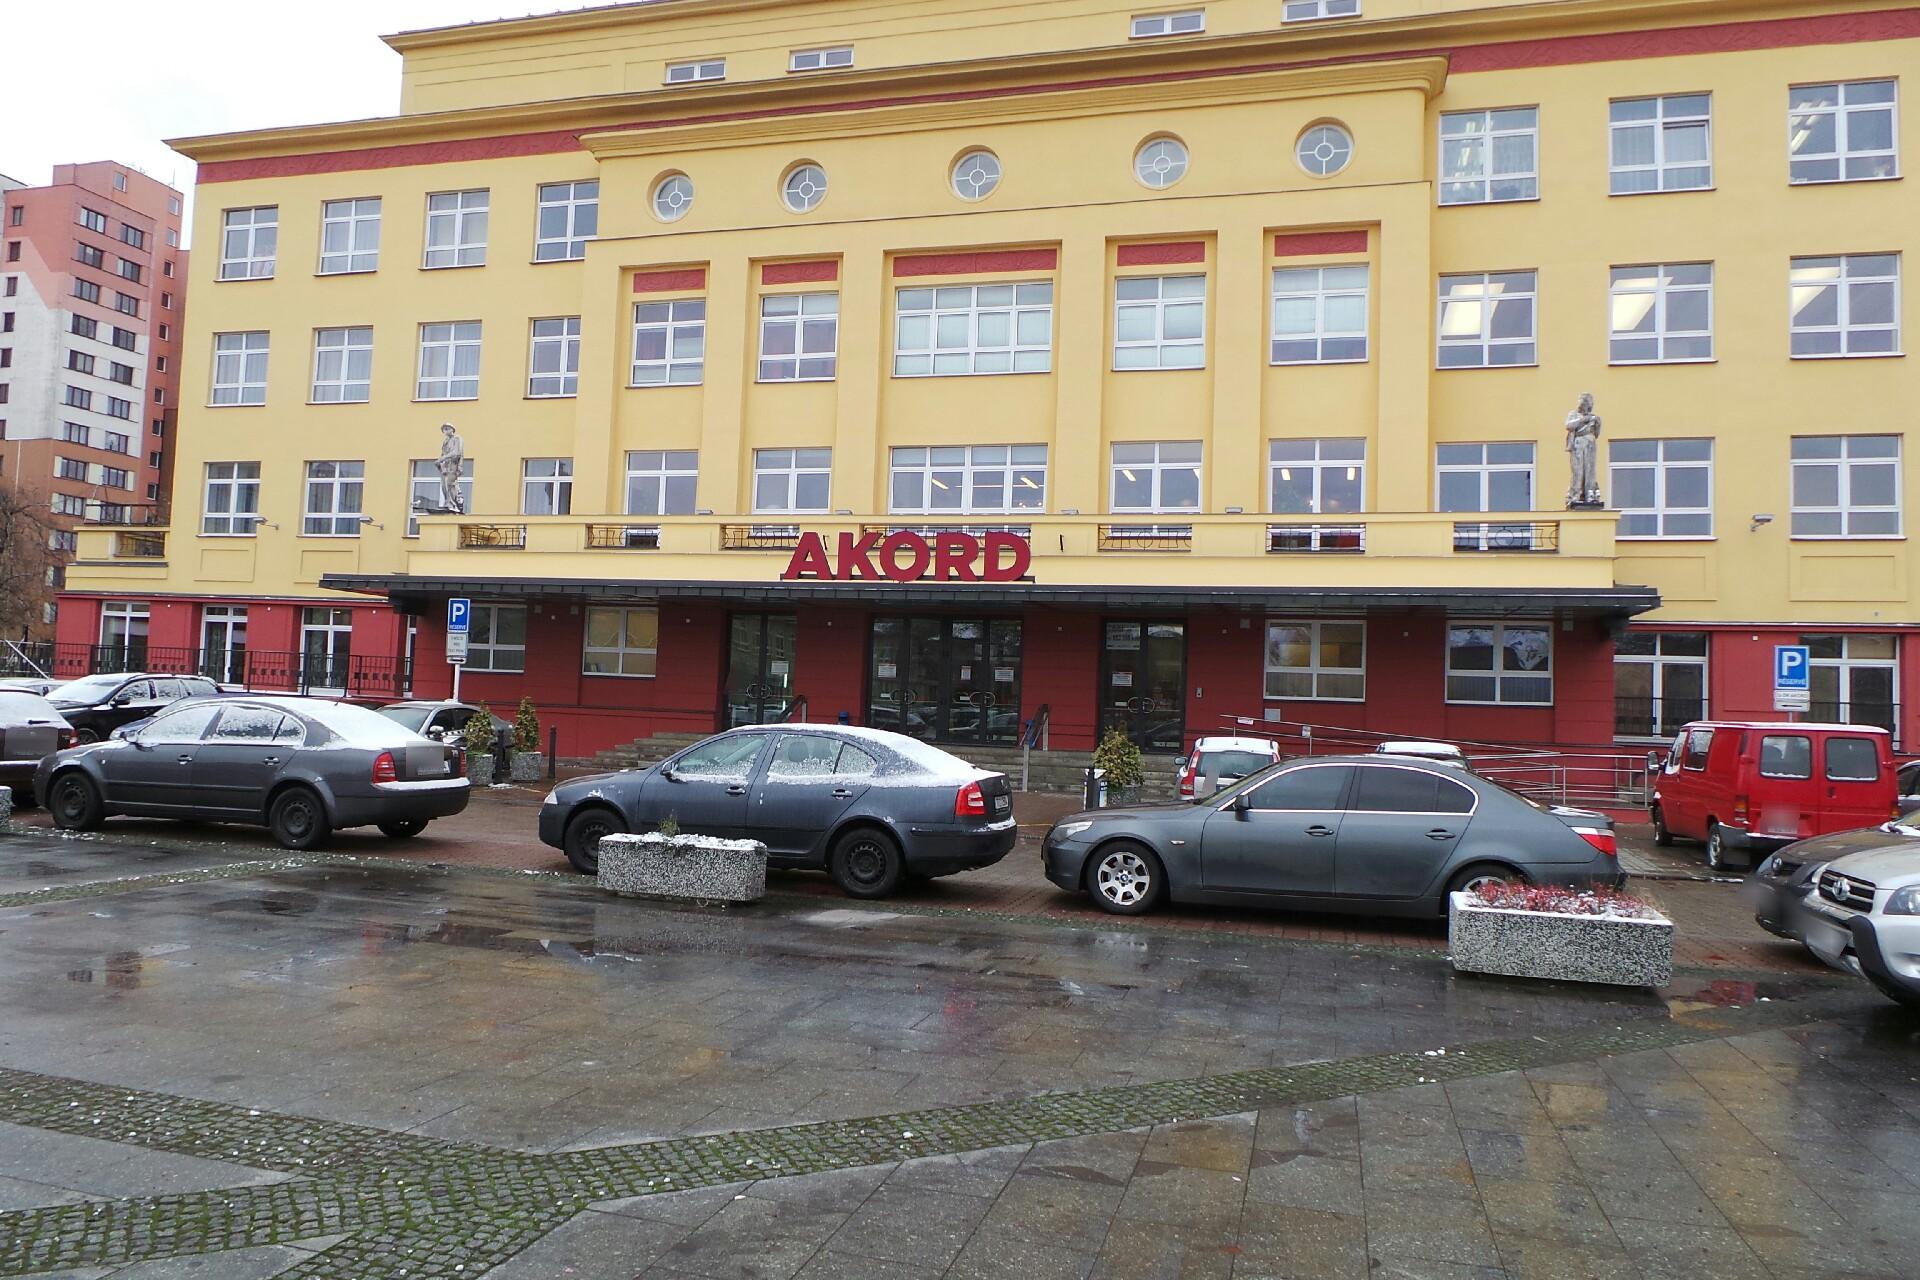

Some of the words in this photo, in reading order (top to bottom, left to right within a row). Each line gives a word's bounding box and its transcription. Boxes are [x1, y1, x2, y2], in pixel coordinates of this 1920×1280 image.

[782, 531, 1031, 582] AKORD
[453, 603, 465, 622] P
[1782, 652, 1802, 675] P
